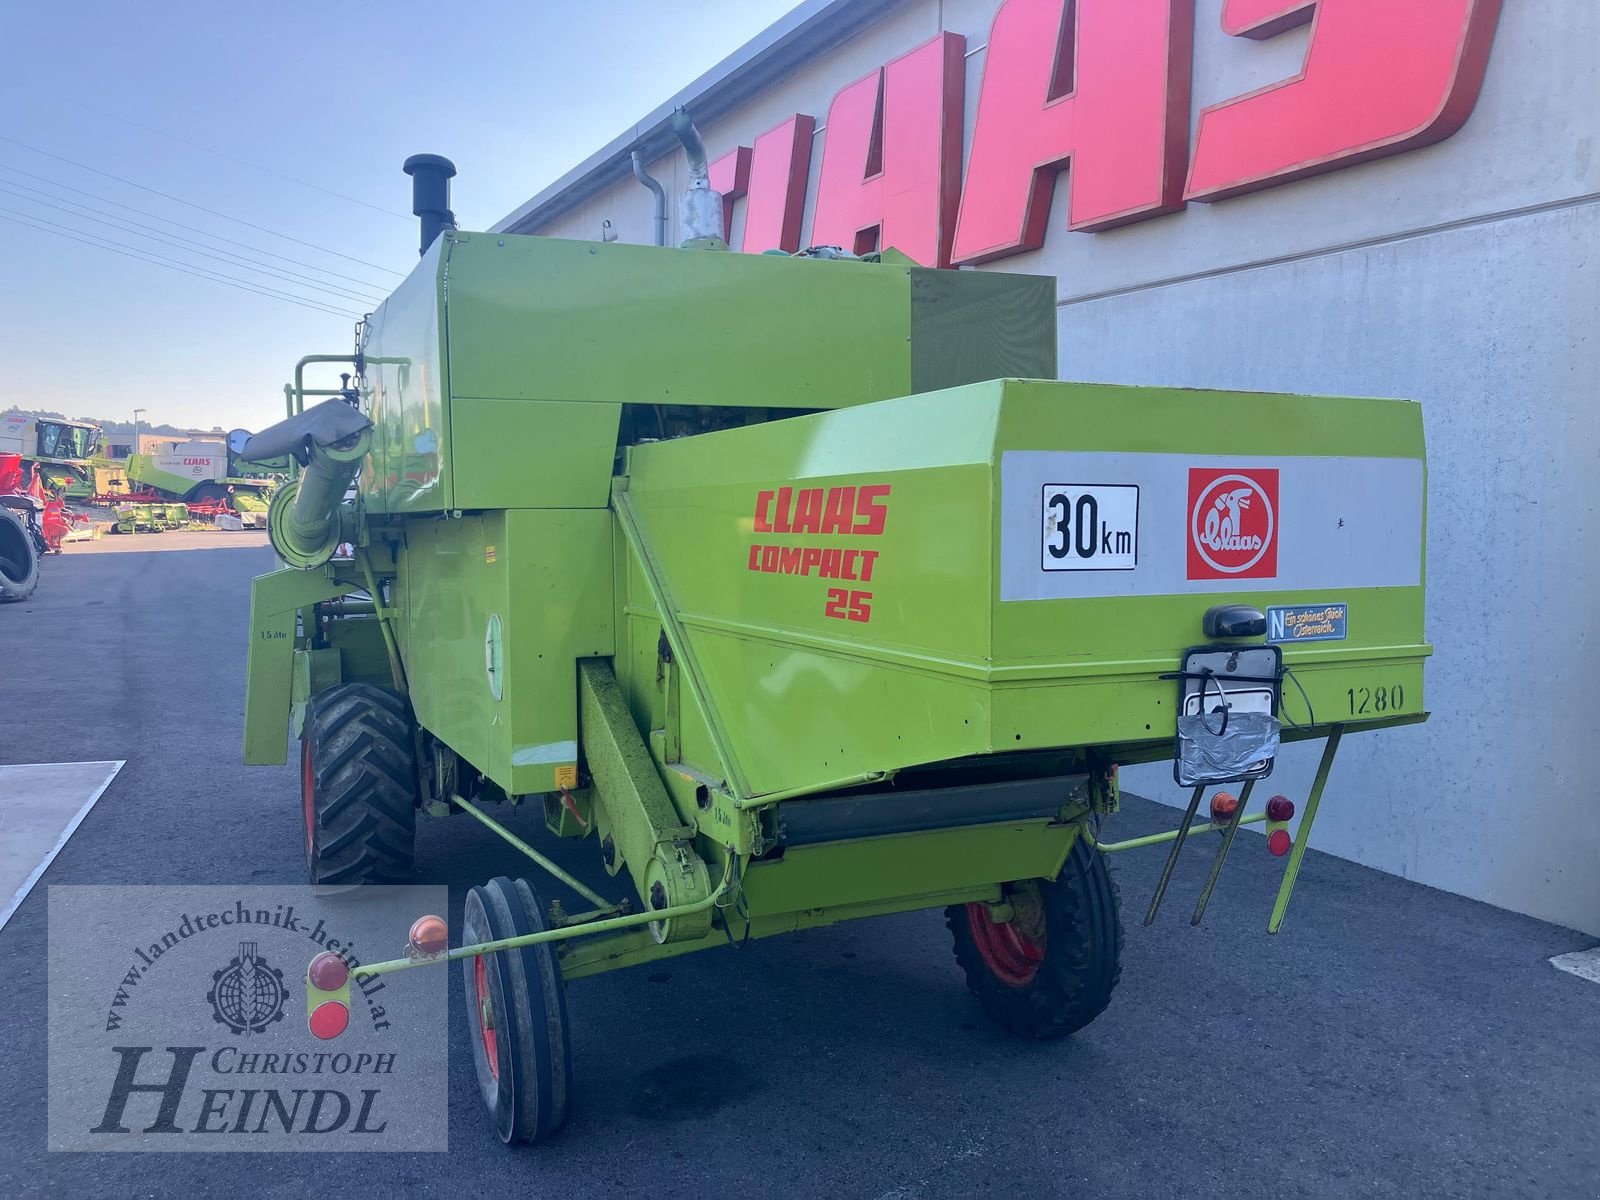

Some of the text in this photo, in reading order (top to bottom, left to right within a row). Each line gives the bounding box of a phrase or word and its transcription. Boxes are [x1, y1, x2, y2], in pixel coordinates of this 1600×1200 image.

[707, 0, 1506, 268] LAAS
[183, 458, 211, 466] CLAAS
[753, 484, 892, 536] CLAAS
[1048, 493, 1132, 559] 30 km
[1200, 507, 1262, 551] Claas
[748, 544, 880, 582] COMPACT
[824, 587, 873, 623] 25
[1285, 611, 1297, 626] Ein
[1271, 609, 1285, 639] N
[1347, 685, 1404, 716] 1280
